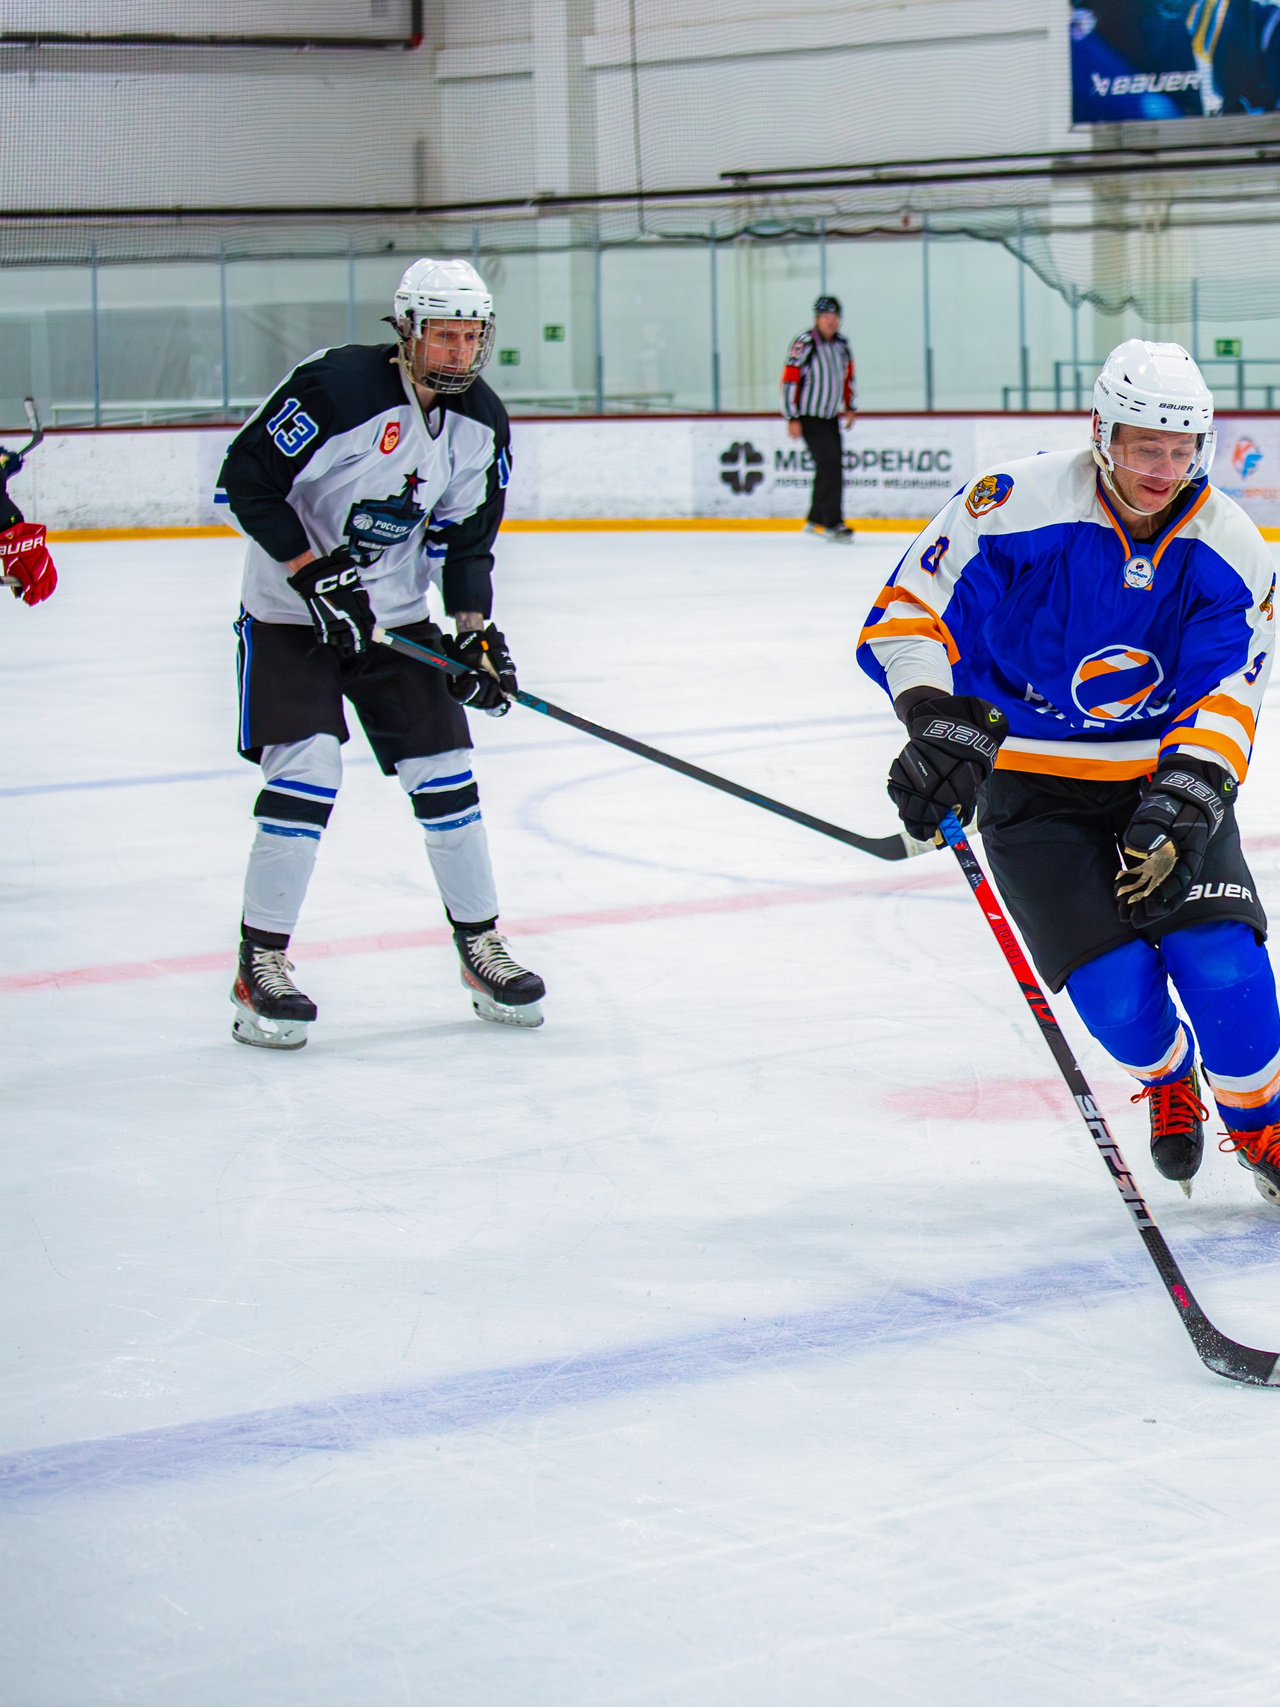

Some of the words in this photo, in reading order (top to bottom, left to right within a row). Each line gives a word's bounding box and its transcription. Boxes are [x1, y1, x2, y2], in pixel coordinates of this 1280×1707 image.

[1111, 71, 1200, 95] BAUER
[1158, 402, 1194, 412] BAUER
[267, 398, 319, 457] 13
[774, 449, 952, 472] МЕФРЕНДС
[0, 536, 44, 556] AUER
[315, 566, 358, 595] CC
[923, 719, 998, 759] BAU
[1161, 771, 1225, 822] BAU
[1185, 882, 1254, 904] AUER
